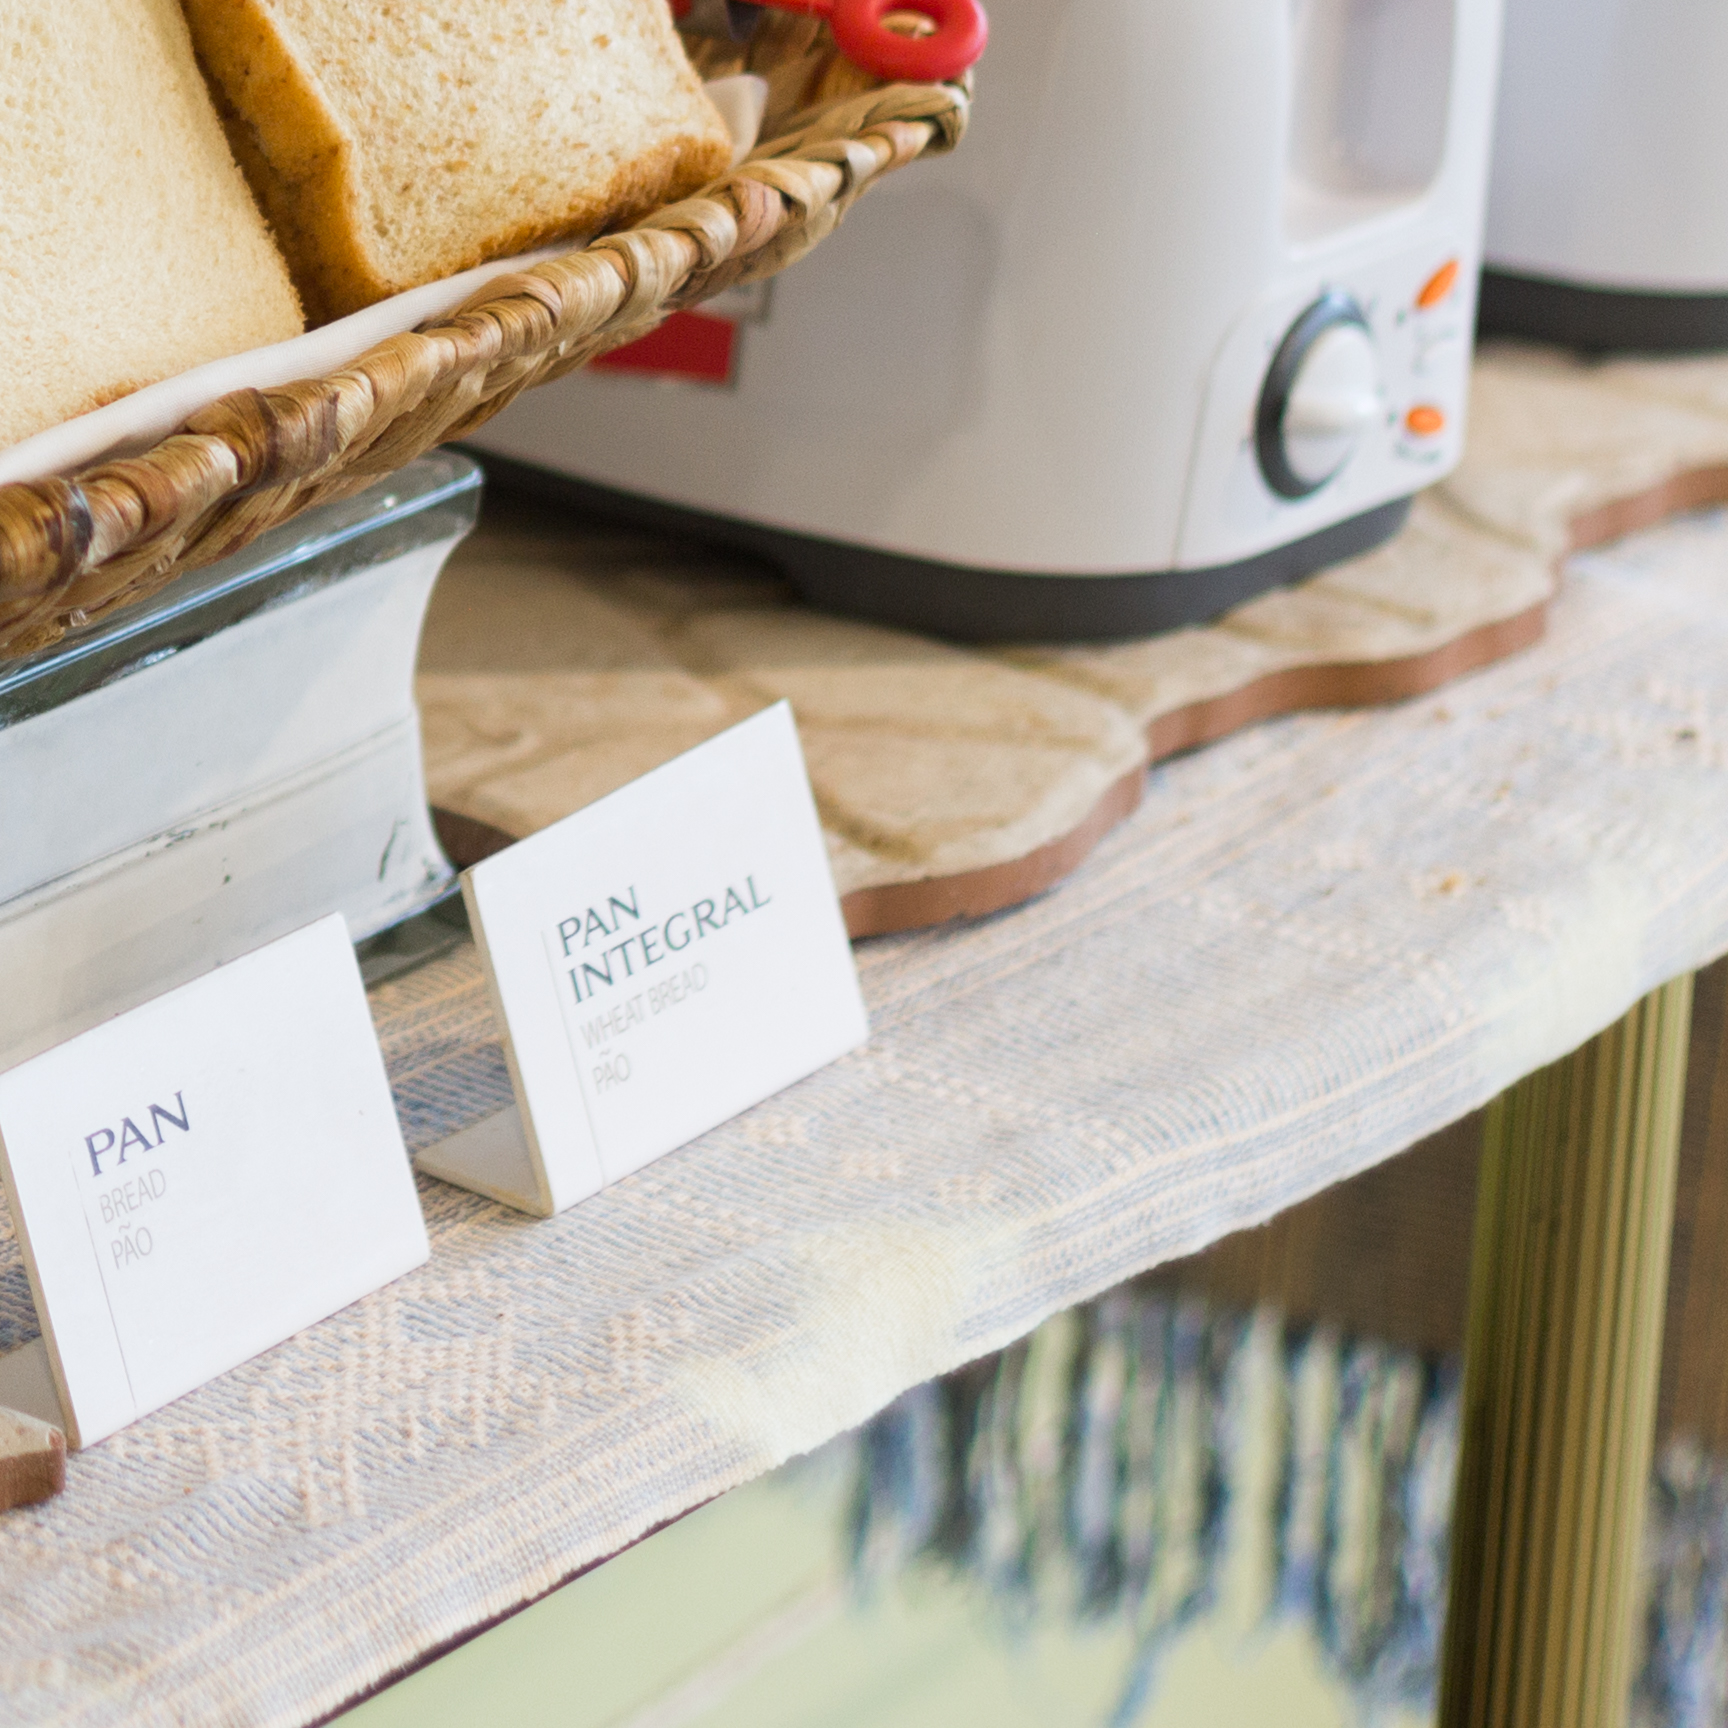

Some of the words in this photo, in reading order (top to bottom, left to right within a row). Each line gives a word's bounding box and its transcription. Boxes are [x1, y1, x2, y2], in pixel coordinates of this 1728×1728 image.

[556, 886, 641, 957] PAN
[568, 875, 772, 1004] INTEGRAL
[579, 993, 644, 1048] WHEAT
[647, 963, 708, 1015] BREAD
[592, 1048, 631, 1094] PÃO
[85, 1090, 190, 1177] PAN
[100, 1169, 166, 1224] BREAD
[111, 1222, 153, 1269] PÃO
